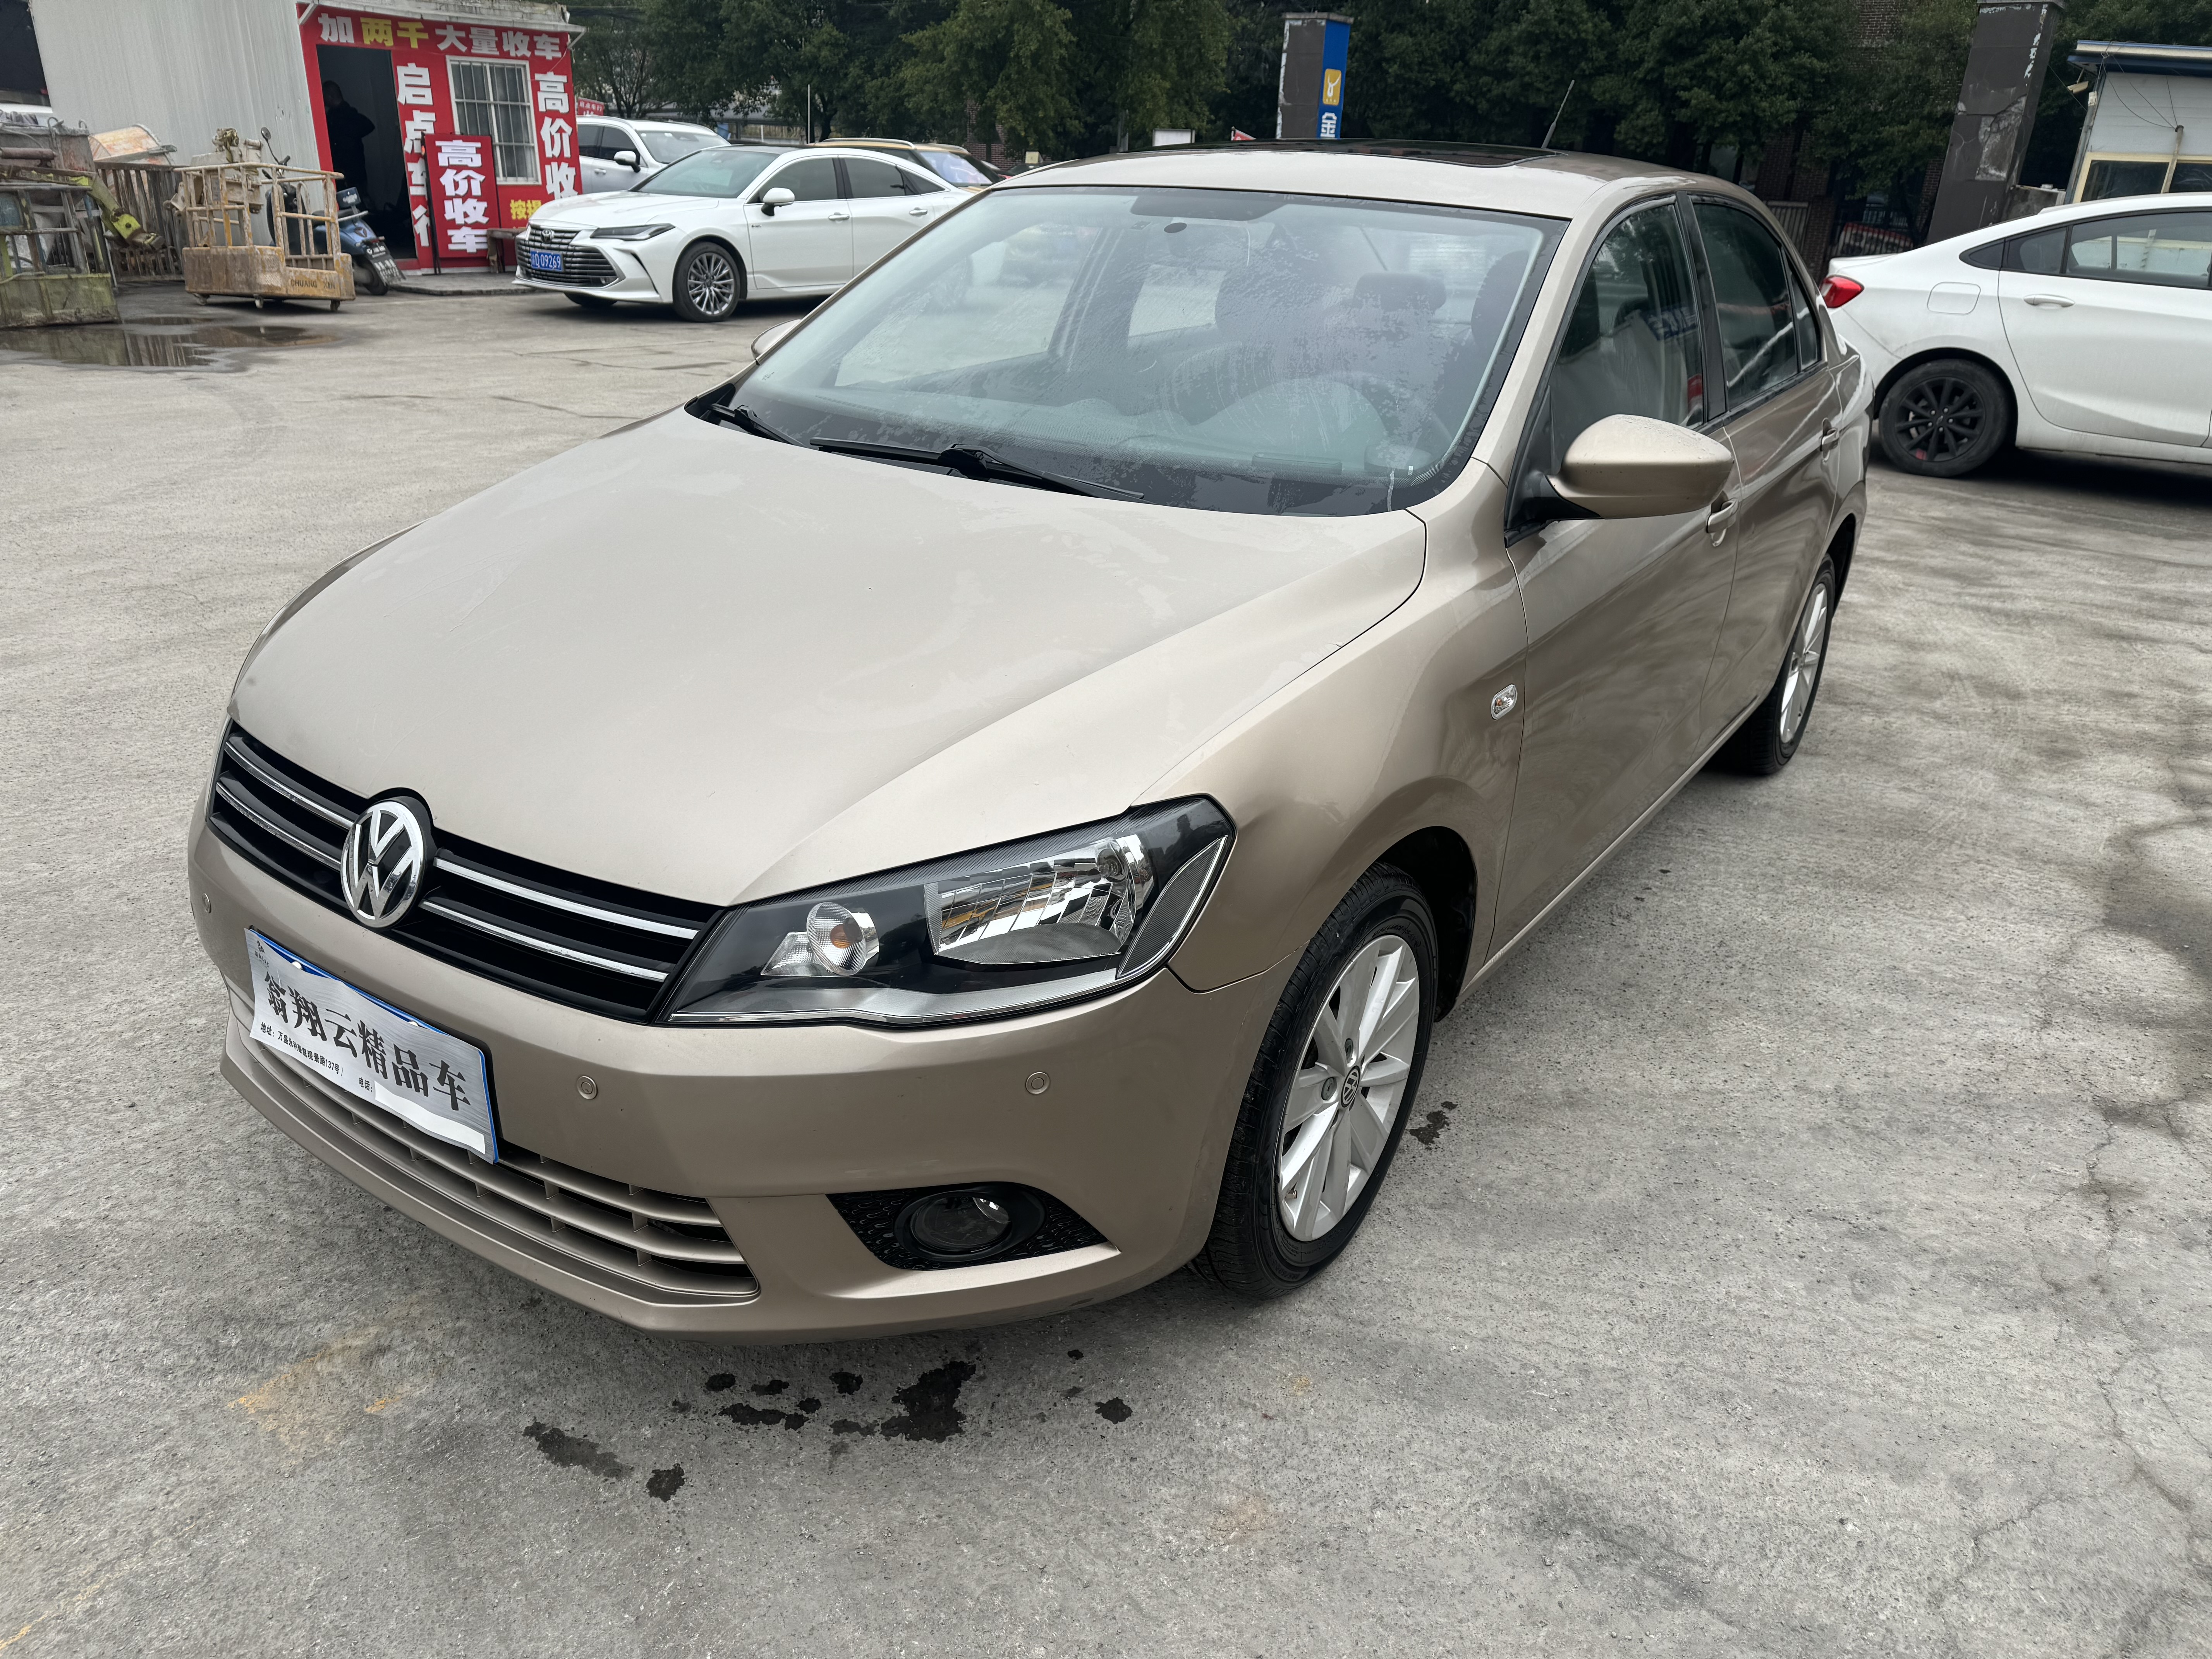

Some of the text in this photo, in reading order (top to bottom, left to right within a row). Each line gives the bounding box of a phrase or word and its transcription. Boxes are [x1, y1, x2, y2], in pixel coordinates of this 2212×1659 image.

[318, 13, 562, 60] 加两千大量收车
[435, 139, 489, 252] 高价收车
[290, 279, 335, 289] CHUANG XIN
[264, 971, 471, 1111] 翁翔云精品车
